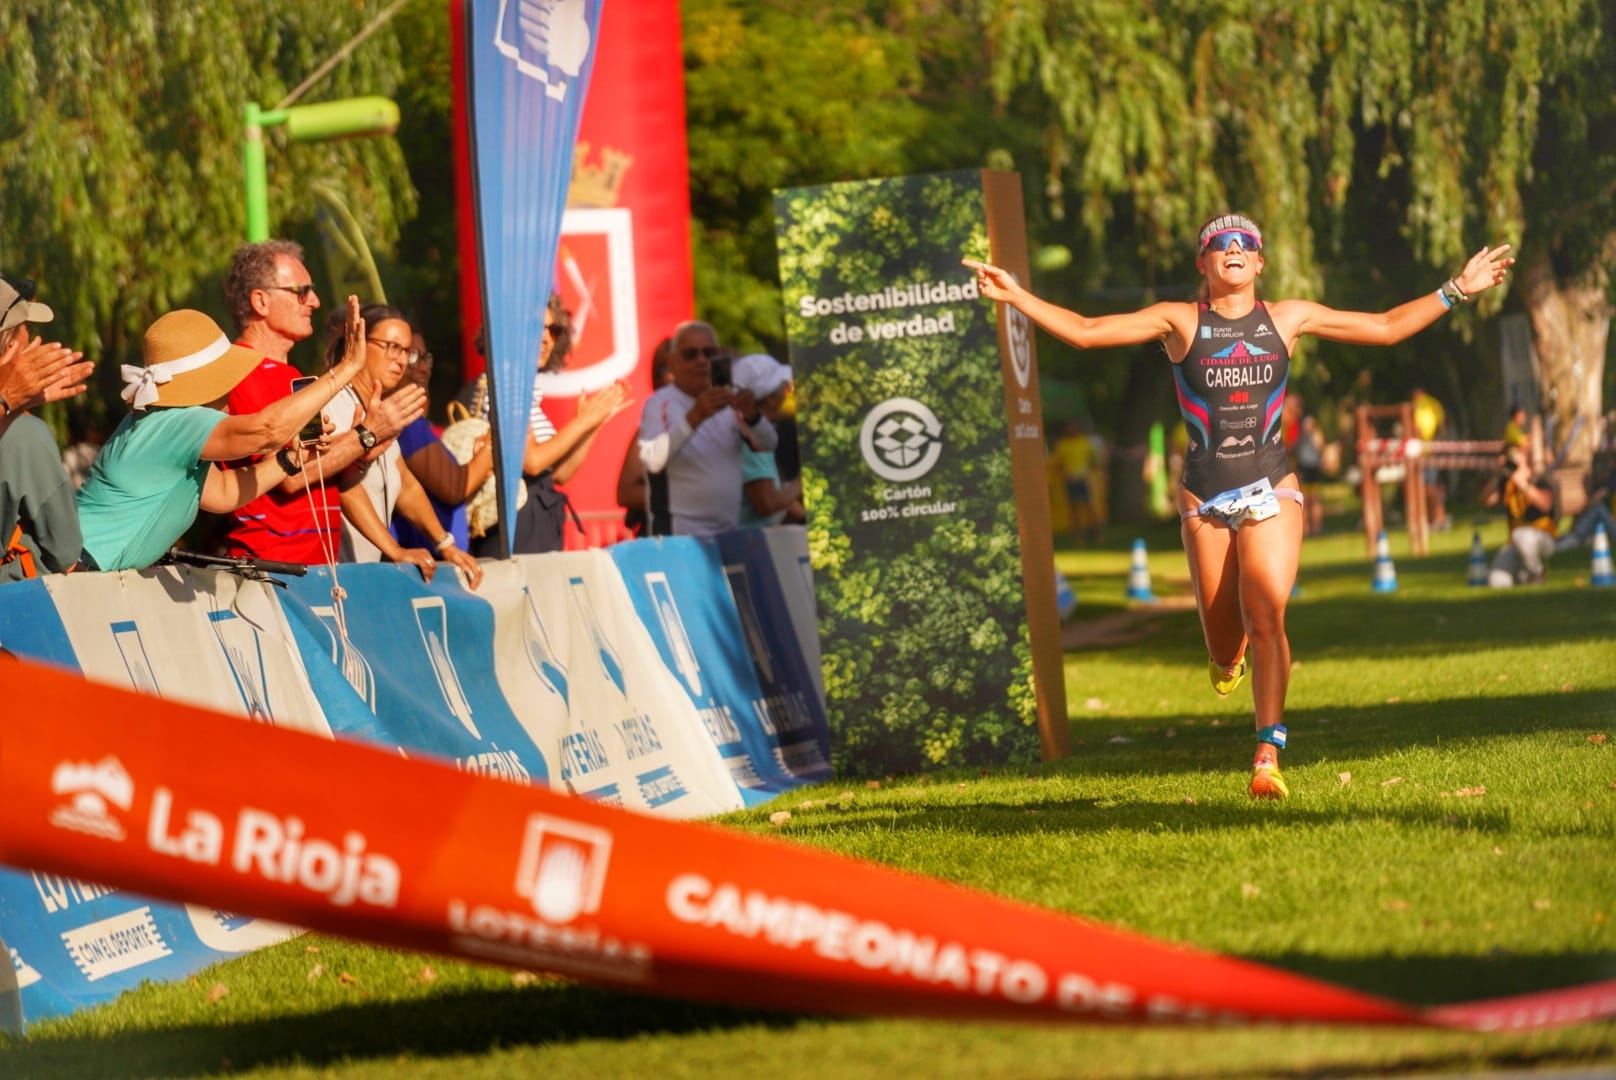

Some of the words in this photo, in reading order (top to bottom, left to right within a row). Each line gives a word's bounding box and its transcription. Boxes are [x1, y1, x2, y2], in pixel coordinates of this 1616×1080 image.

[799, 277, 979, 318] Sostenibilidad
[829, 322, 863, 345] de
[866, 311, 956, 340] verdad
[1200, 357, 1235, 366] CIDADE
[1238, 356, 1252, 365] DE
[1254, 354, 1280, 363] LUGO
[1206, 364, 1273, 388] CARBALLO
[882, 485, 931, 501] Cartón
[861, 506, 899, 522] 100%
[901, 502, 957, 517] circular
[147, 786, 225, 865] La
[233, 808, 401, 909] Rioja
[666, 872, 1047, 1004] CAMPEONATO
